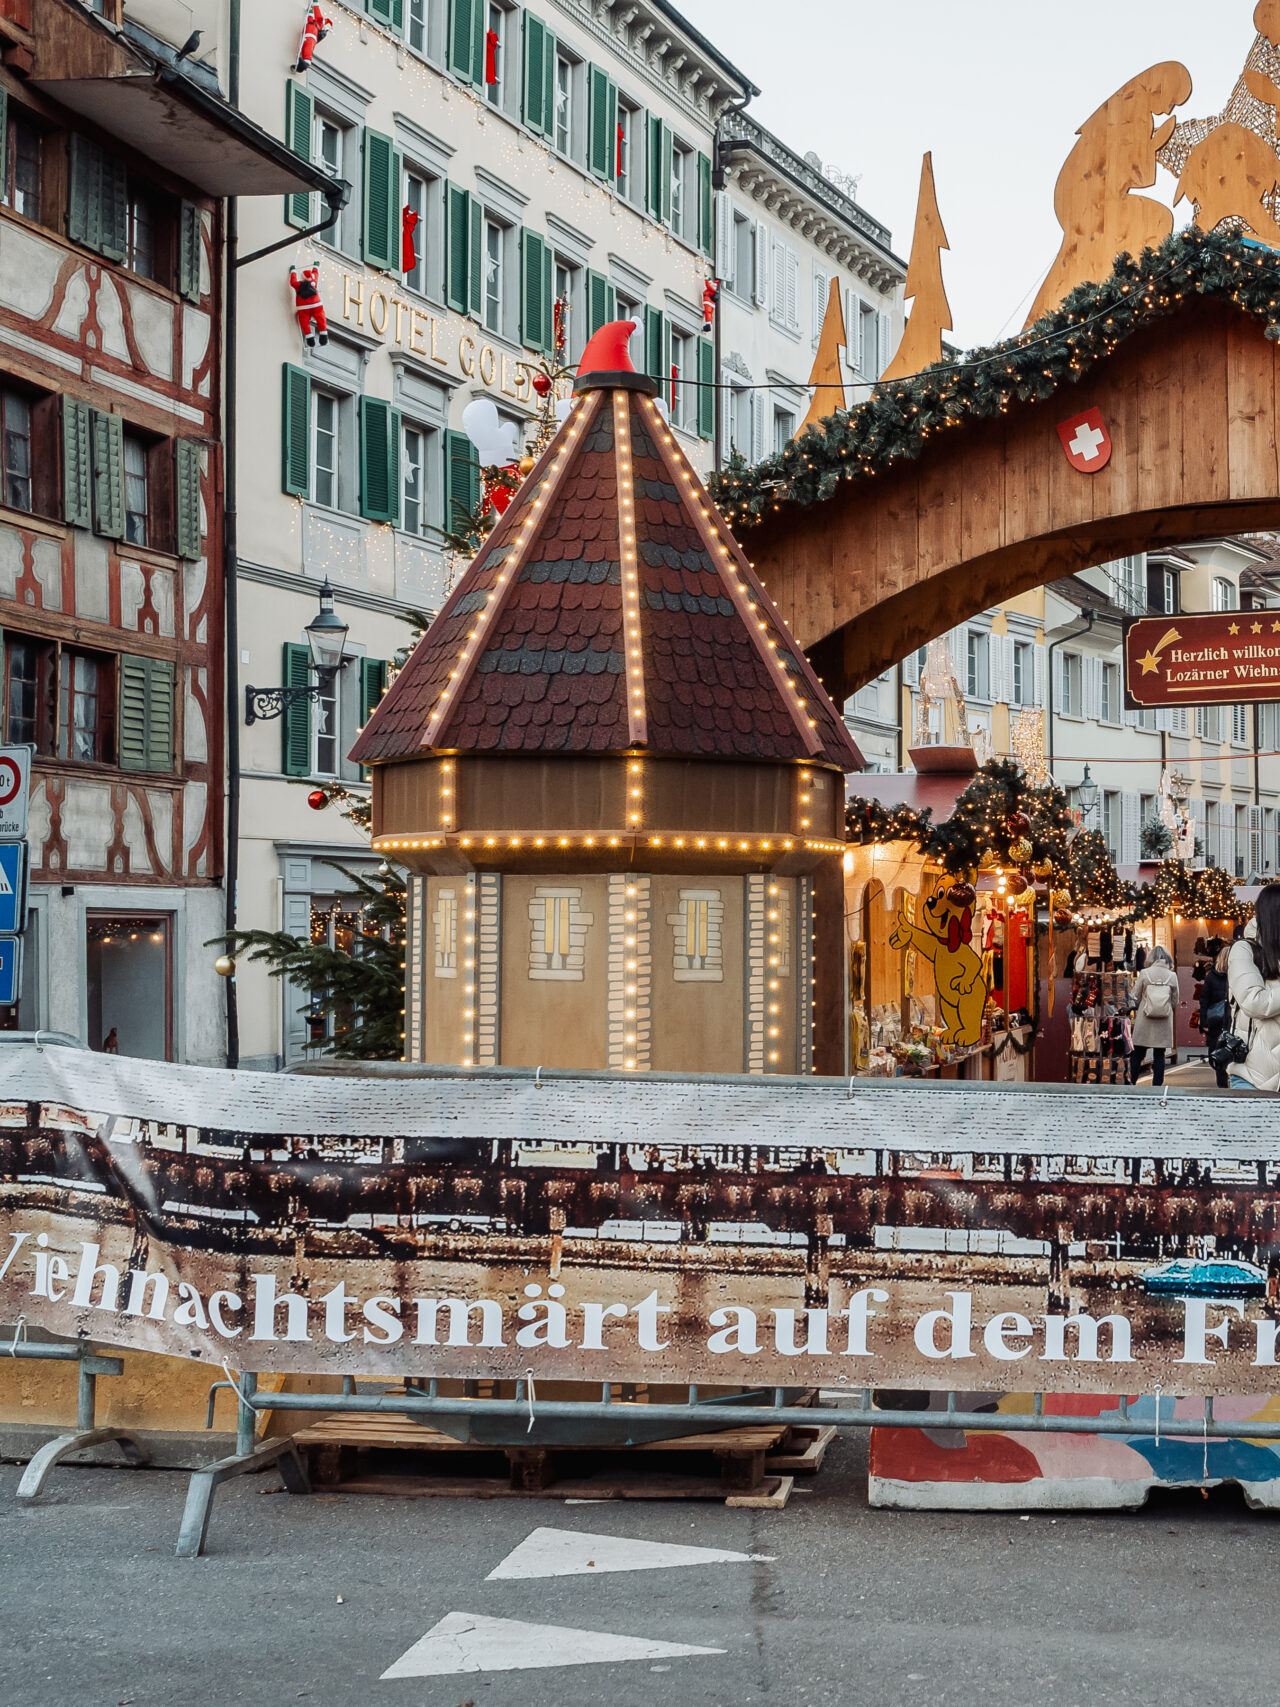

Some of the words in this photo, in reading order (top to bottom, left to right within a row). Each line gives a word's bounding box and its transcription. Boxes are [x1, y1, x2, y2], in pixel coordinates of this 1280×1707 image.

[343, 274, 448, 366] HOTEL
[1171, 648, 1229, 663] Herzlich
[1166, 669, 1230, 682] Lozärner
[0, 821, 20, 832] rücke
[706, 1288, 889, 1356] auf
[914, 1291, 1137, 1363] dem
